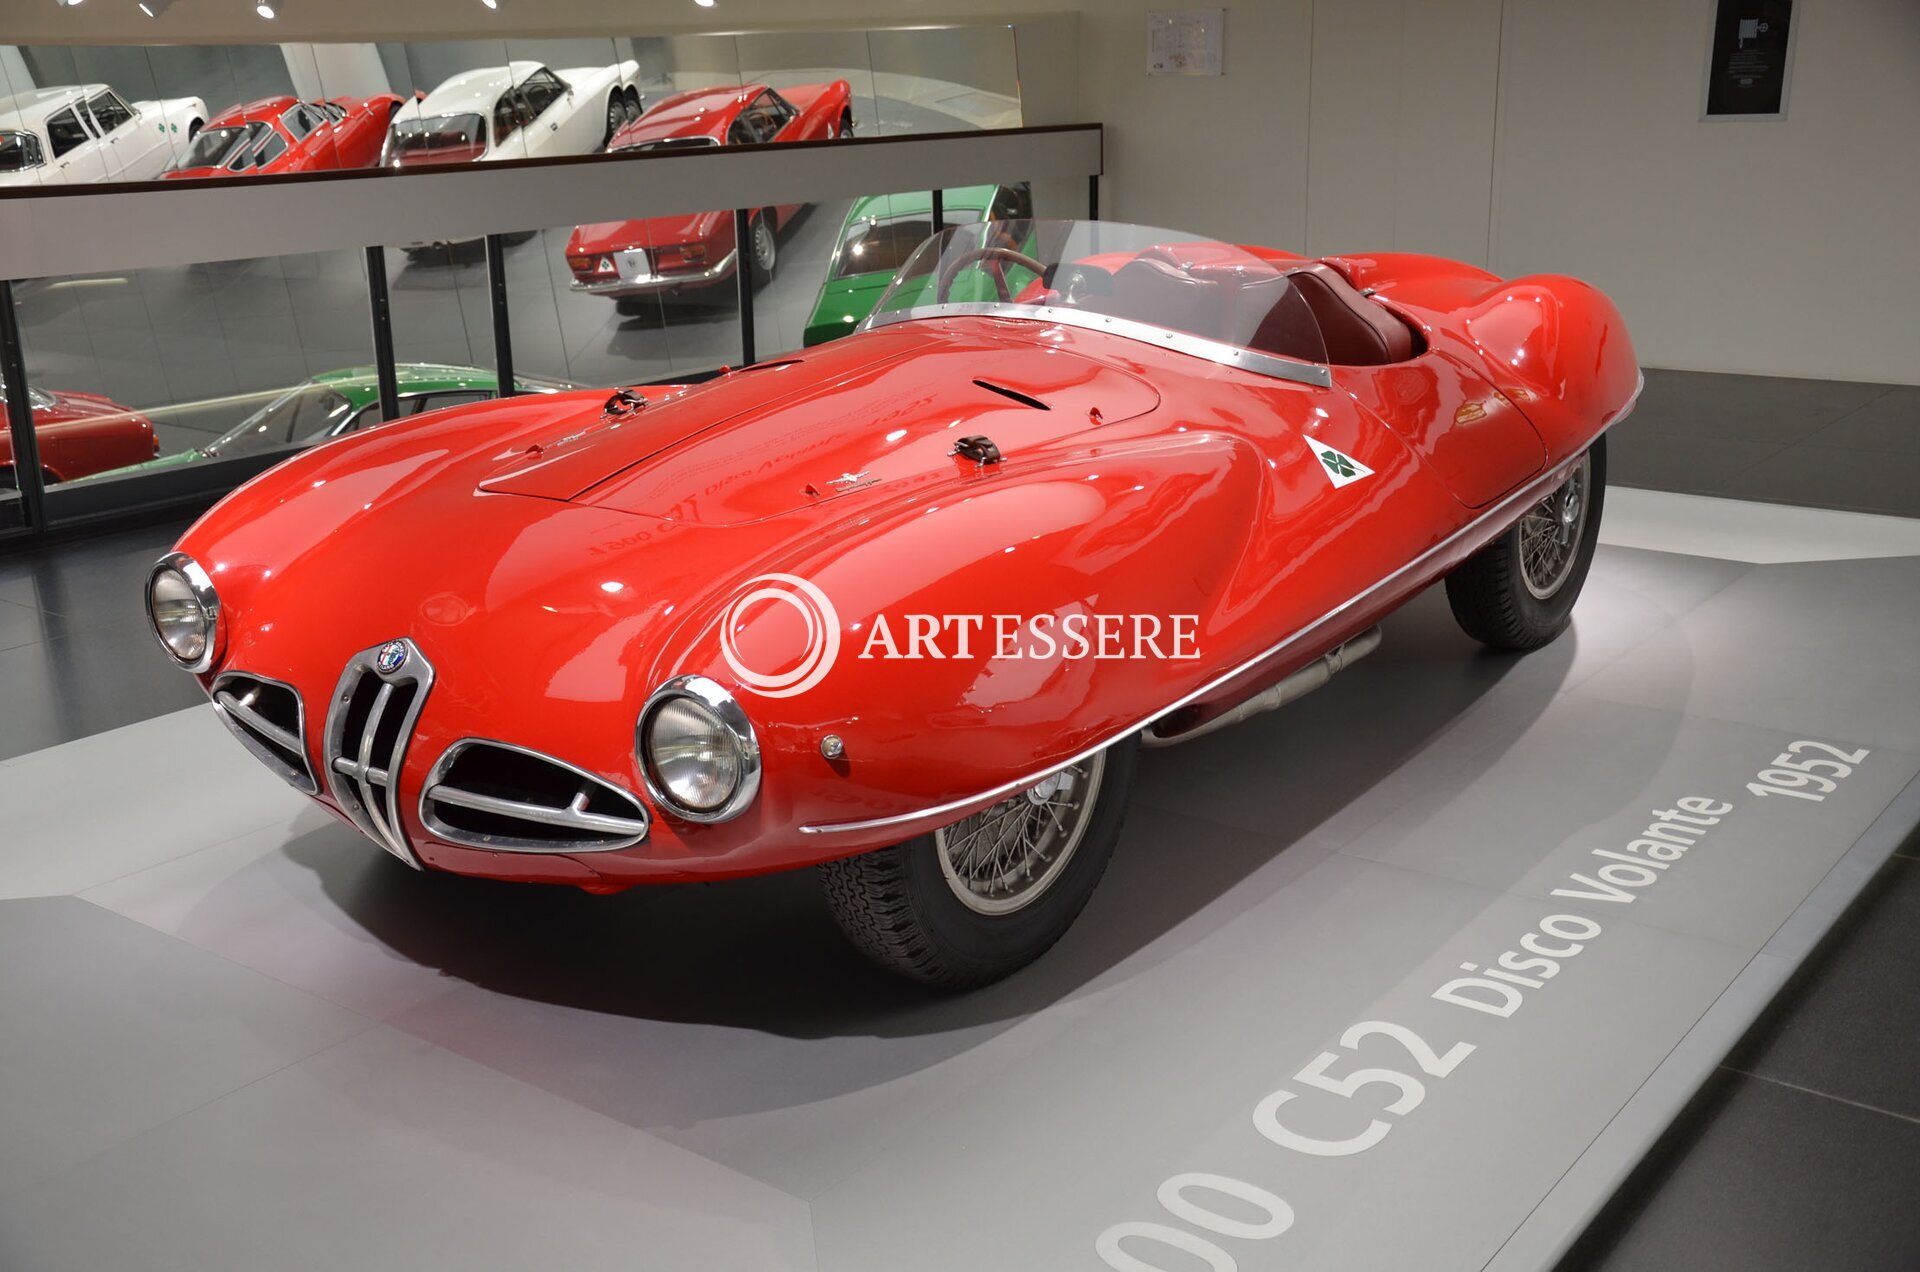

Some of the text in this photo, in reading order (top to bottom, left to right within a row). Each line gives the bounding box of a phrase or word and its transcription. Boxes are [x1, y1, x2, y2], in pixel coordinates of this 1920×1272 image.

[1252, 1020, 1477, 1157] C52
[1431, 914, 1602, 1019] Disco
[1550, 796, 1734, 904] Volante
[1745, 740, 1871, 802] 1952
